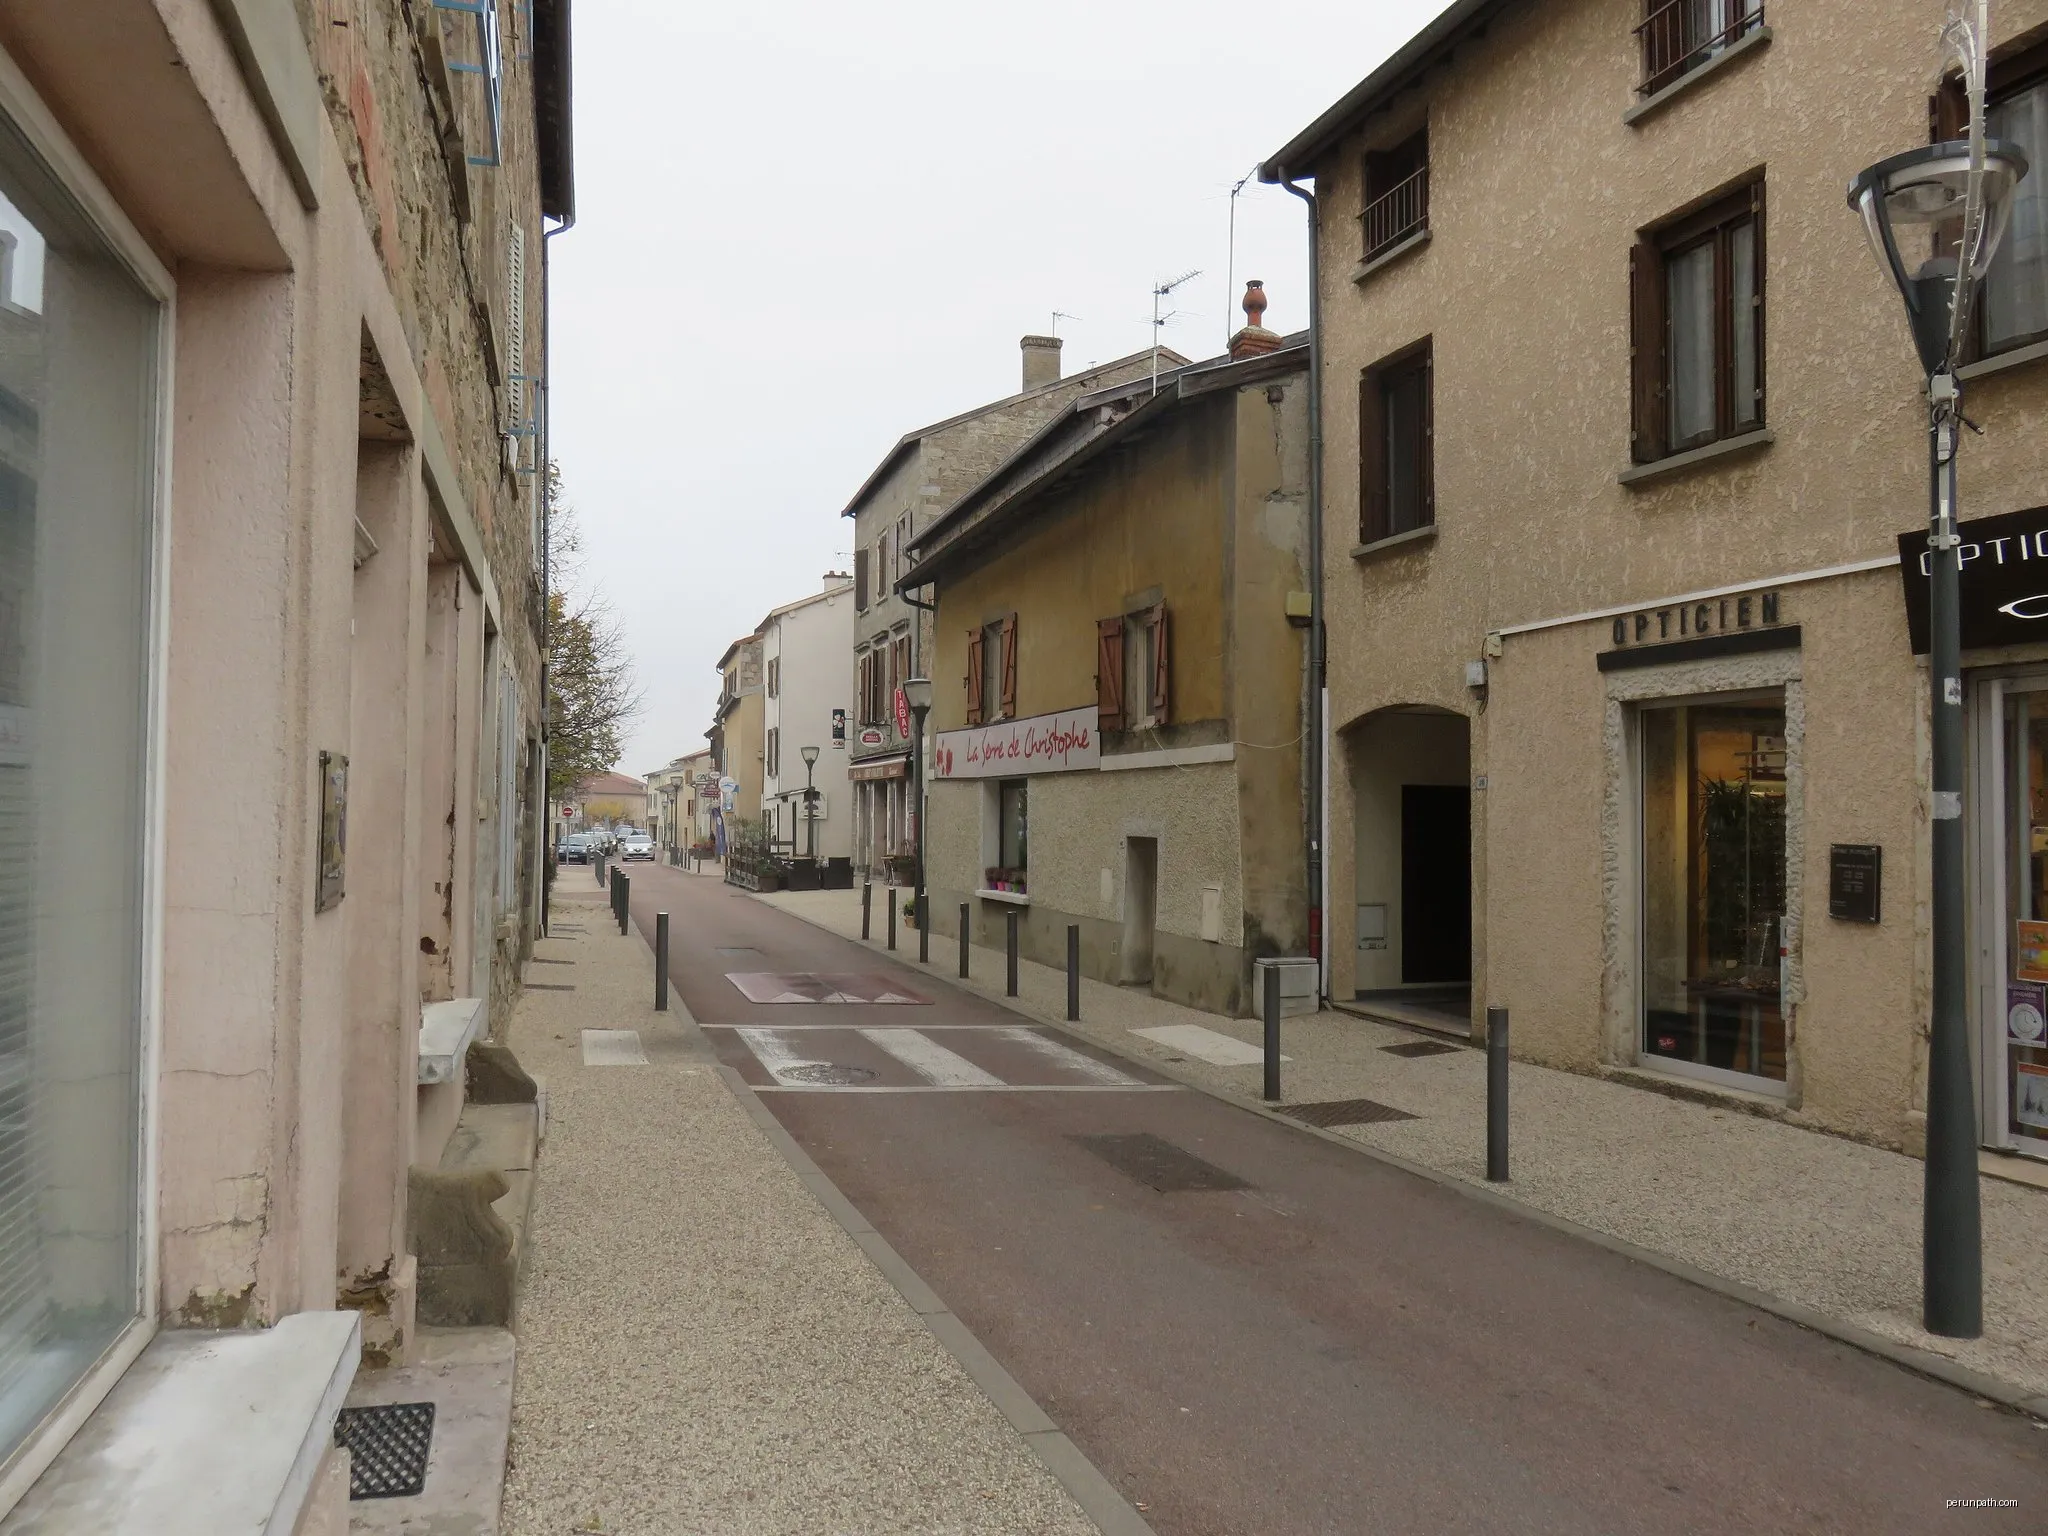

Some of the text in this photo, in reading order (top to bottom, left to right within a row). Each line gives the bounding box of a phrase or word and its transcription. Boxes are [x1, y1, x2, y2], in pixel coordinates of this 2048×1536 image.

[1613, 592, 1779, 645] OPTICIEN
[897, 690, 909, 736] TABAC
[967, 718, 1089, 768] La Serre de Christophe
